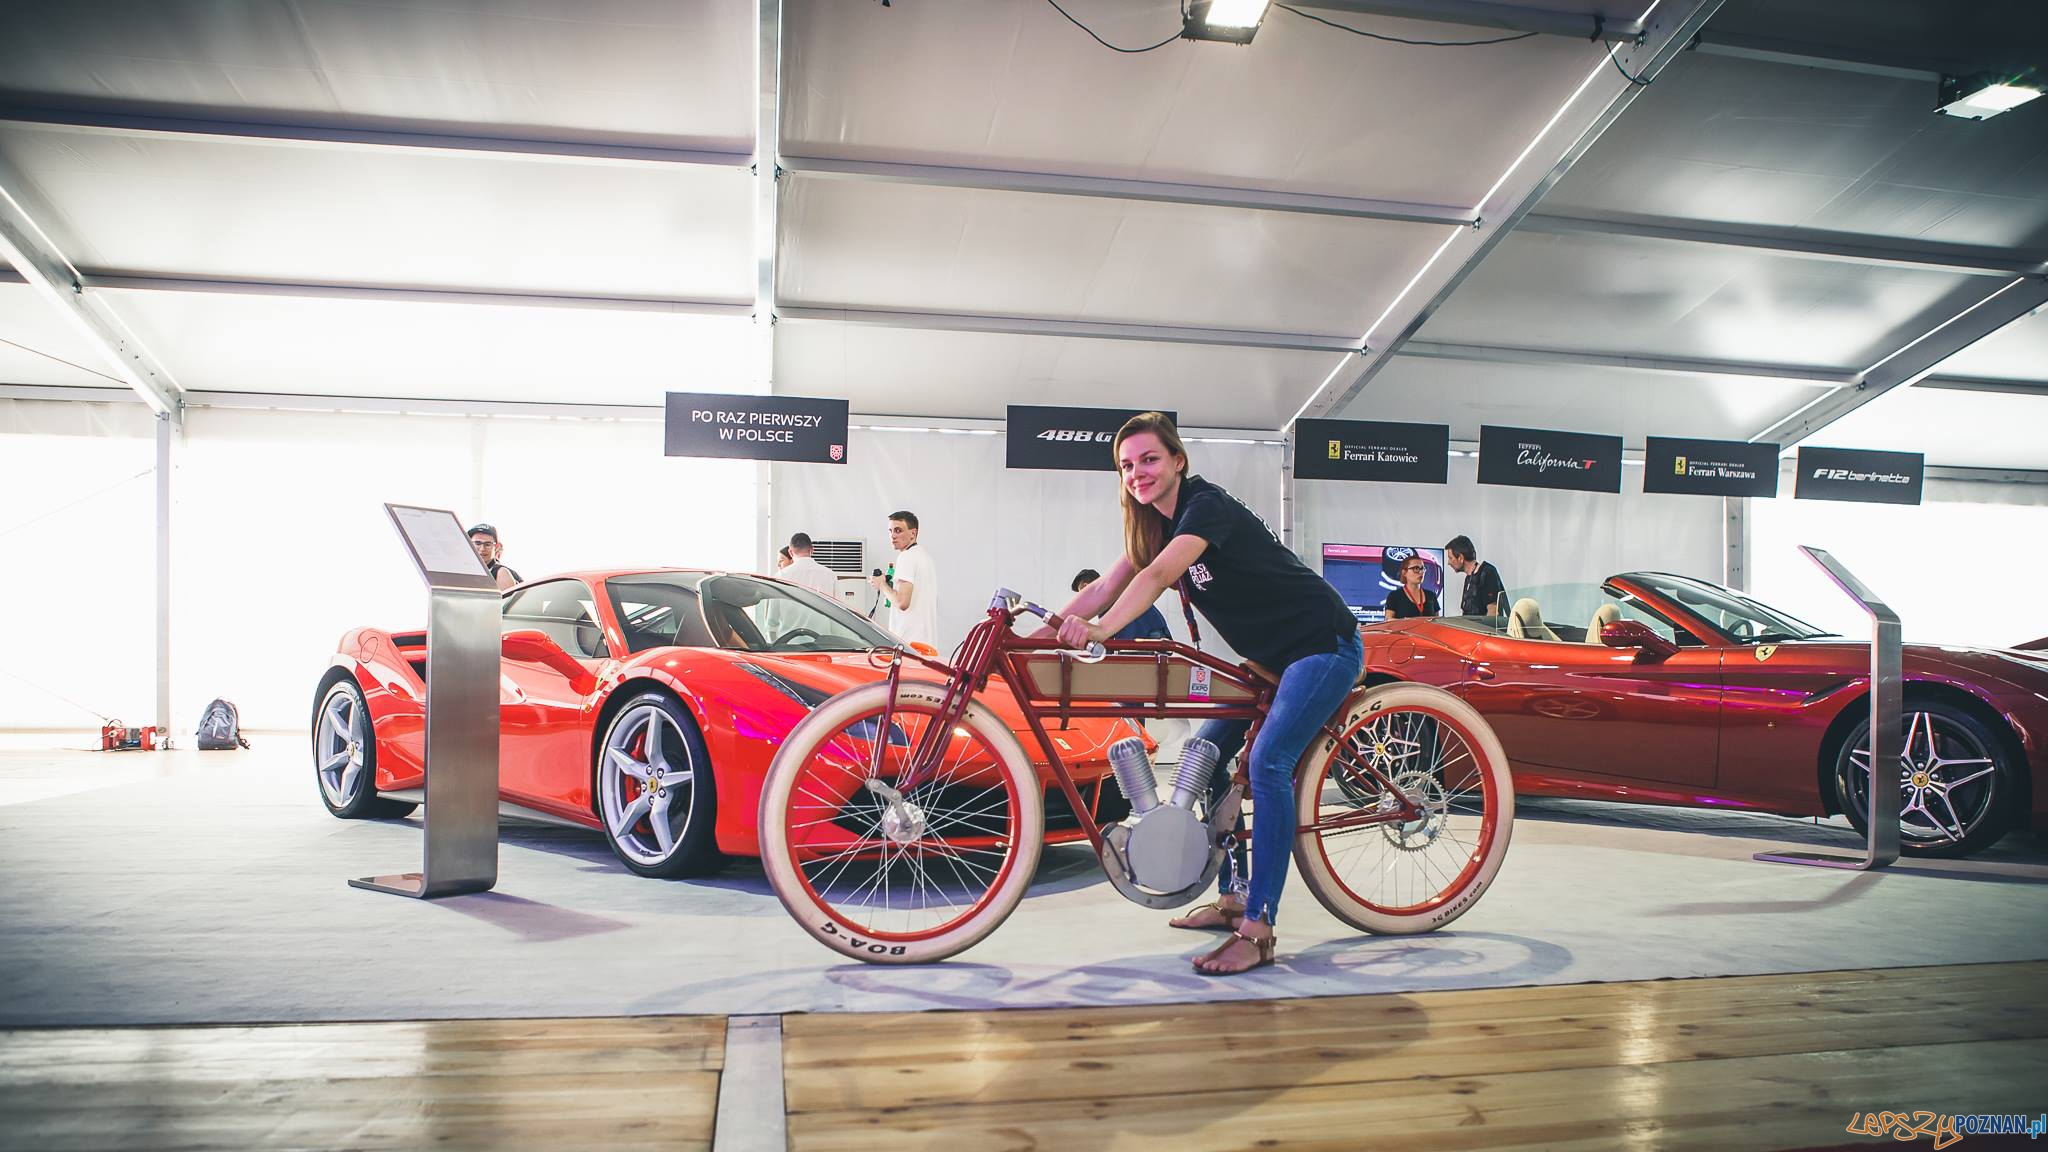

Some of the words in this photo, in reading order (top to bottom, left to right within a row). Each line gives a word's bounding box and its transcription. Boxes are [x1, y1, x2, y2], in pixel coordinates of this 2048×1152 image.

[692, 410, 713, 423] PO
[716, 412, 746, 424] RAZ
[749, 413, 822, 428] PIERWSZY
[719, 428, 734, 440] W
[737, 428, 794, 443] POLSCE
[1036, 429, 1093, 442] 488
[1344, 450, 1375, 461] Ferrari
[1377, 451, 1418, 463] Katowice
[1516, 449, 1583, 473] California
[1582, 458, 1597, 470] T
[1688, 465, 1716, 477] Ferrari
[1717, 467, 1756, 479] Warszawa
[1325, 700, 1382, 754] BA-G
[820, 921, 907, 955] BOA-G
